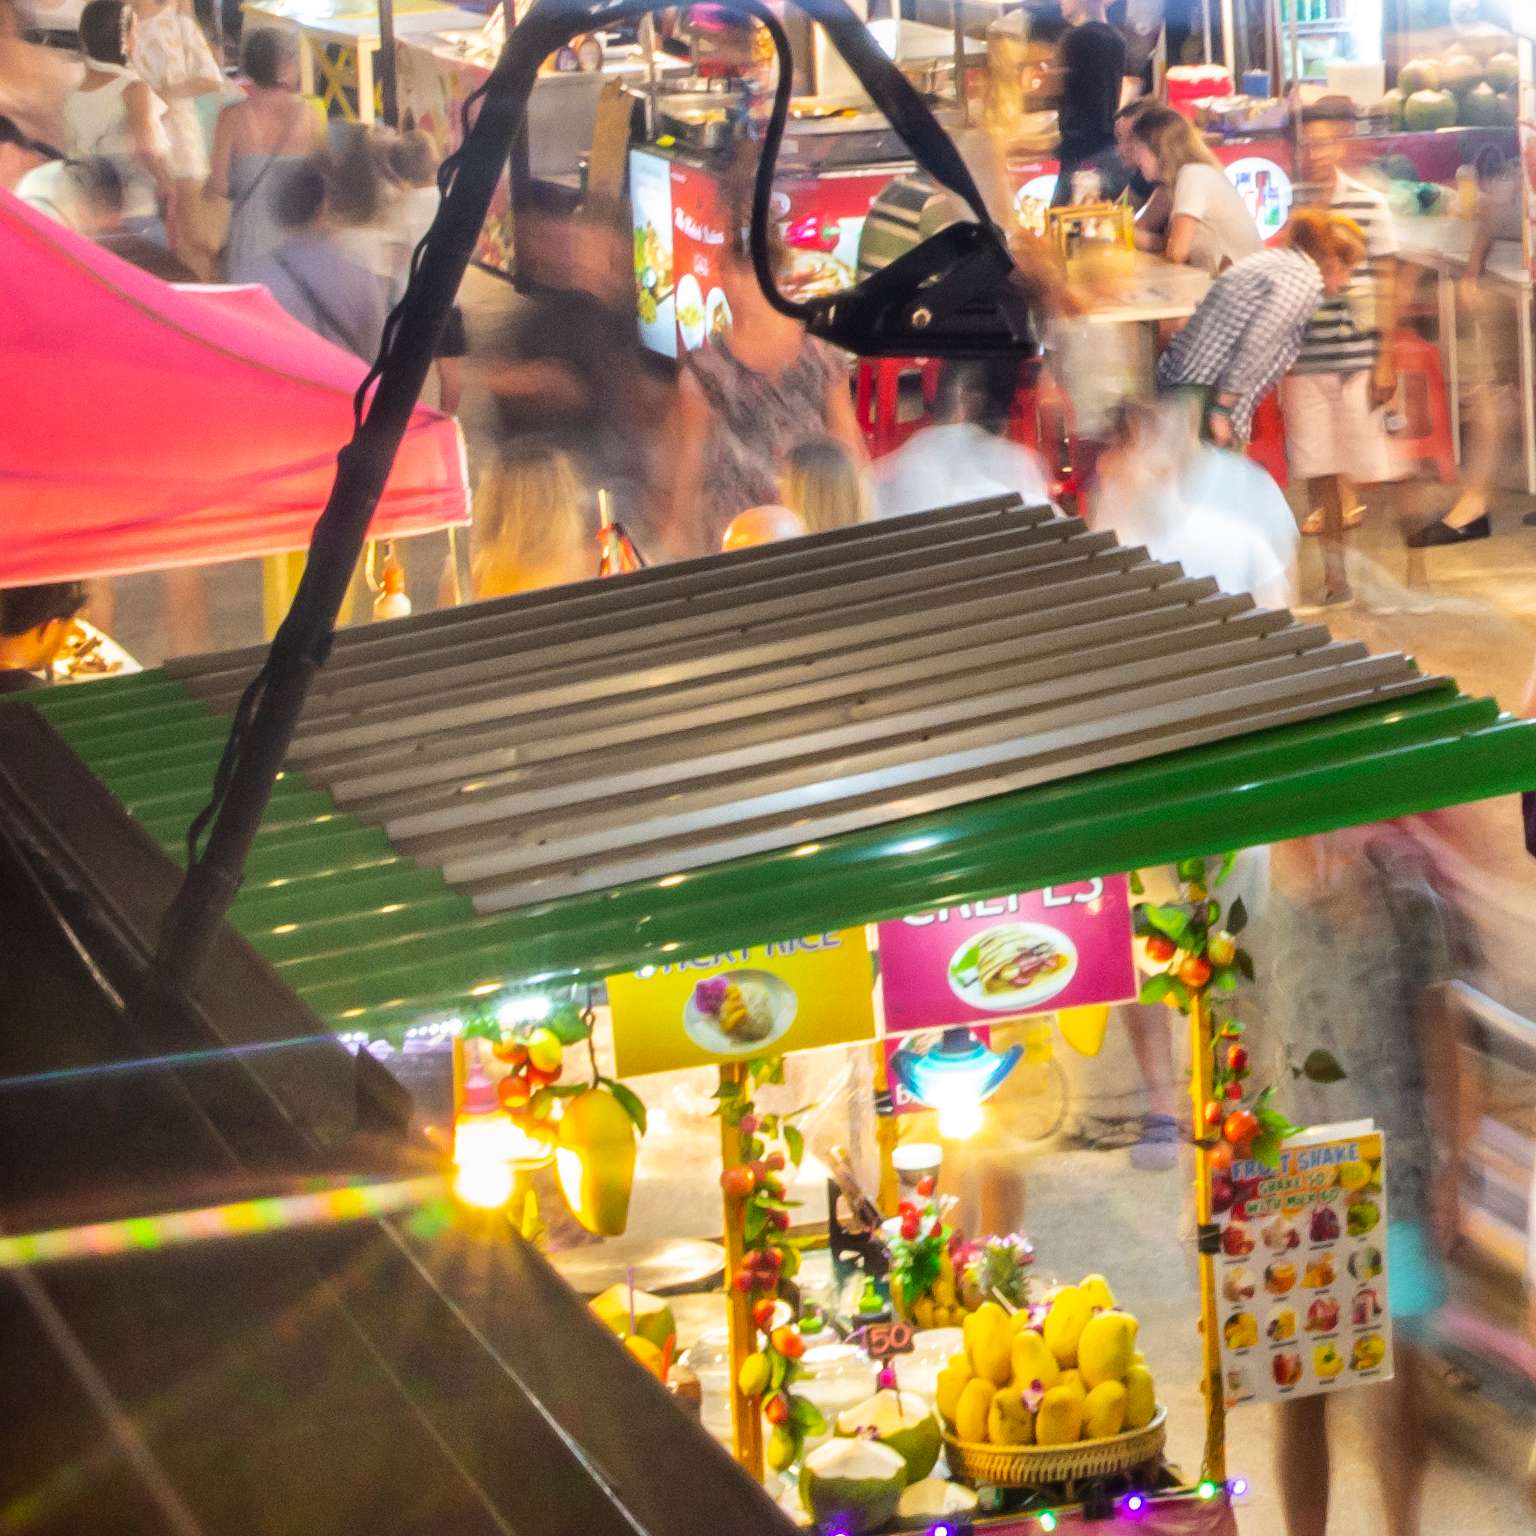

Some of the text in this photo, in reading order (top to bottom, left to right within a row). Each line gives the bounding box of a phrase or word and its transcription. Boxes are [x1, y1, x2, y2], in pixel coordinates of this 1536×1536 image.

[1231, 1142, 1361, 1181] FRT SHAKE
[870, 1323, 911, 1355] 50
